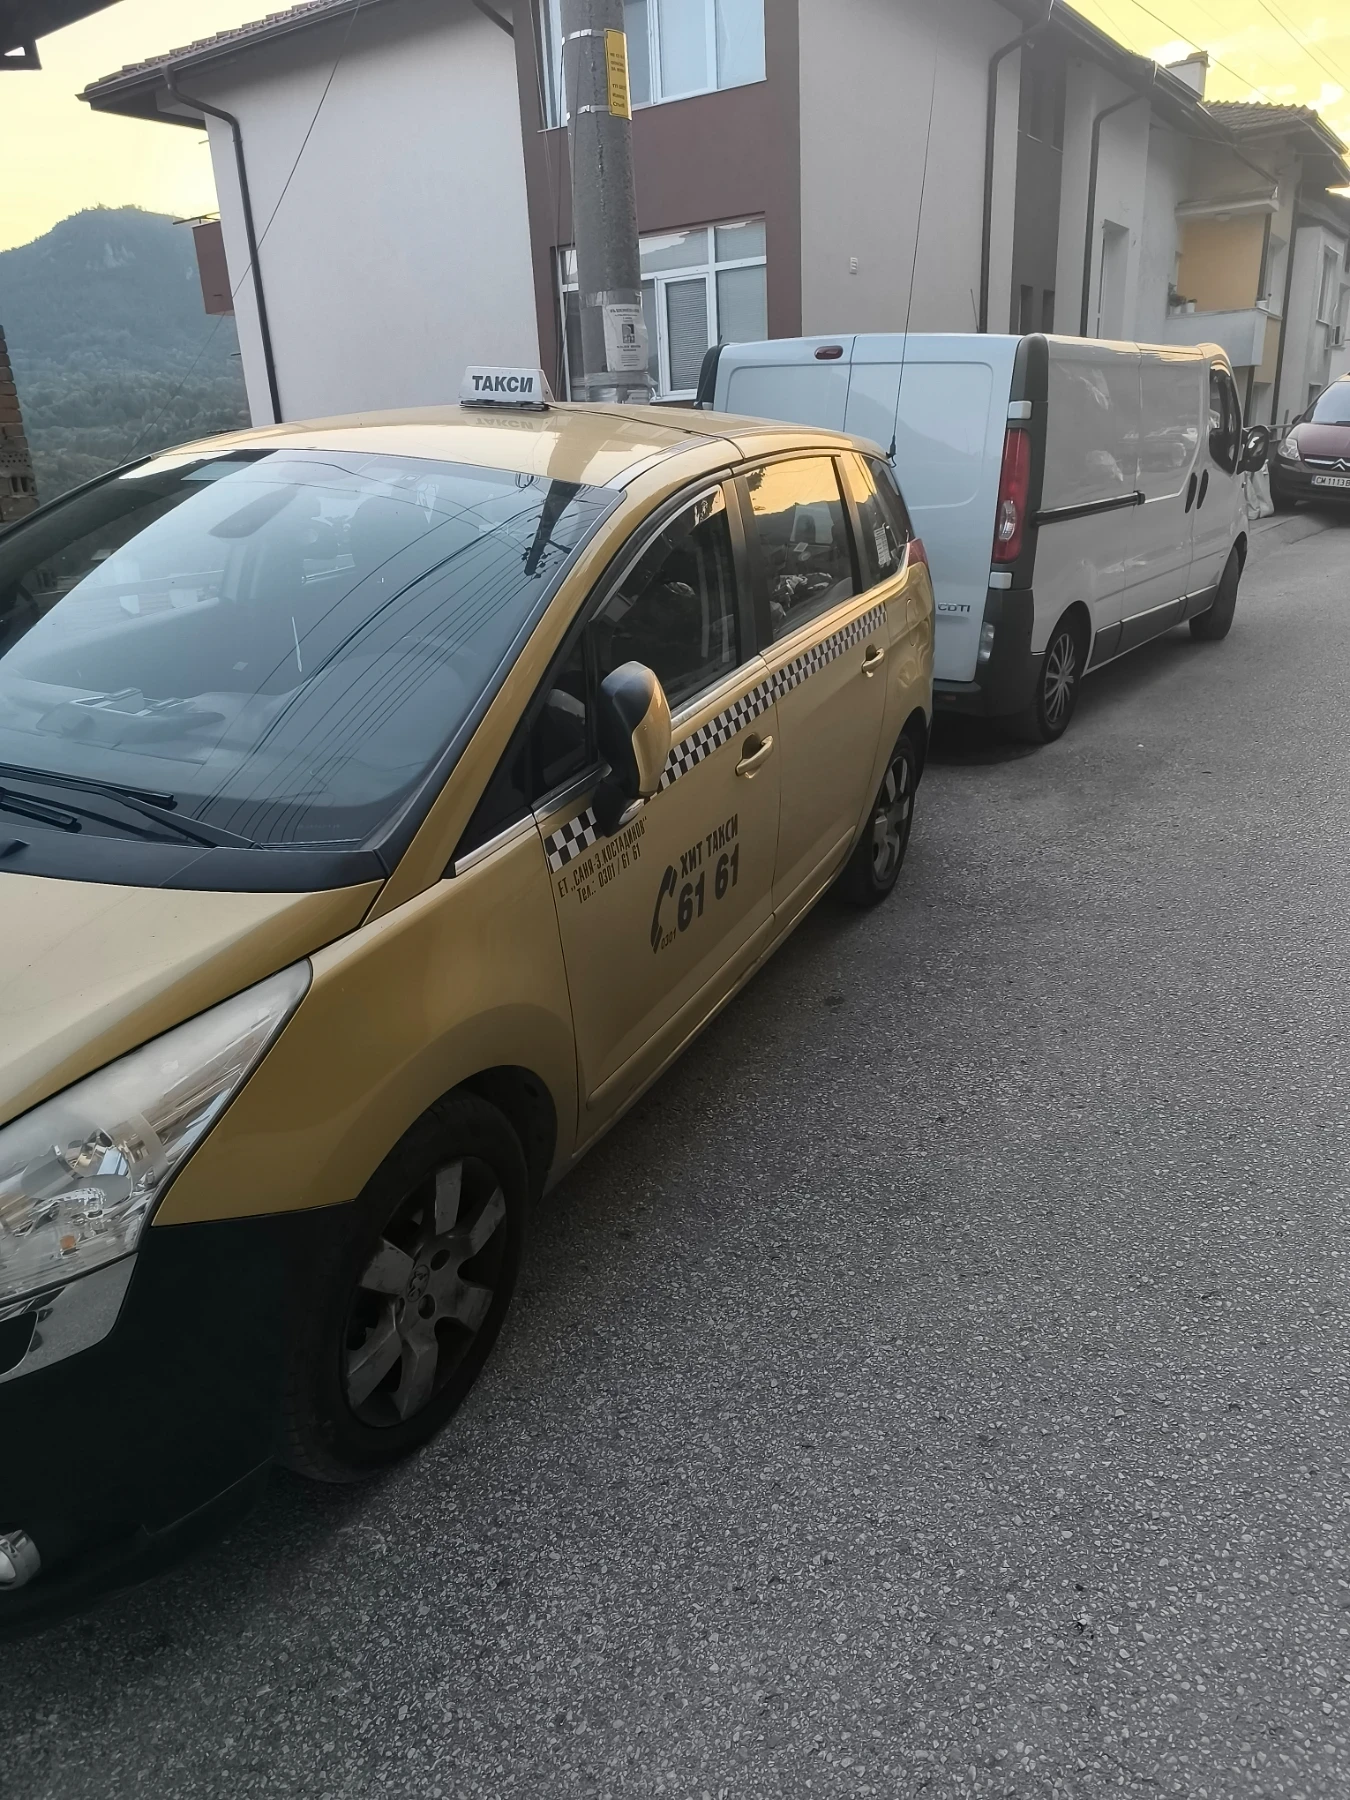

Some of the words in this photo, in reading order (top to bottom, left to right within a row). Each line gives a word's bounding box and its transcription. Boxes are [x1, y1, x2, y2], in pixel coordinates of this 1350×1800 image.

[472, 375, 534, 393] ТАКСИ
[937, 603, 971, 613] CDTI
[680, 840, 703, 879] ХИТ
[705, 813, 739, 858] ТАКСИ
[598, 863, 616, 888] 0301
[621, 851, 630, 869] 61
[632, 842, 641, 861] 61
[558, 877, 569, 898] ЕТ
[677, 870, 706, 933] 61
[714, 842, 740, 901] 61
[660, 927, 677, 950] 0301
